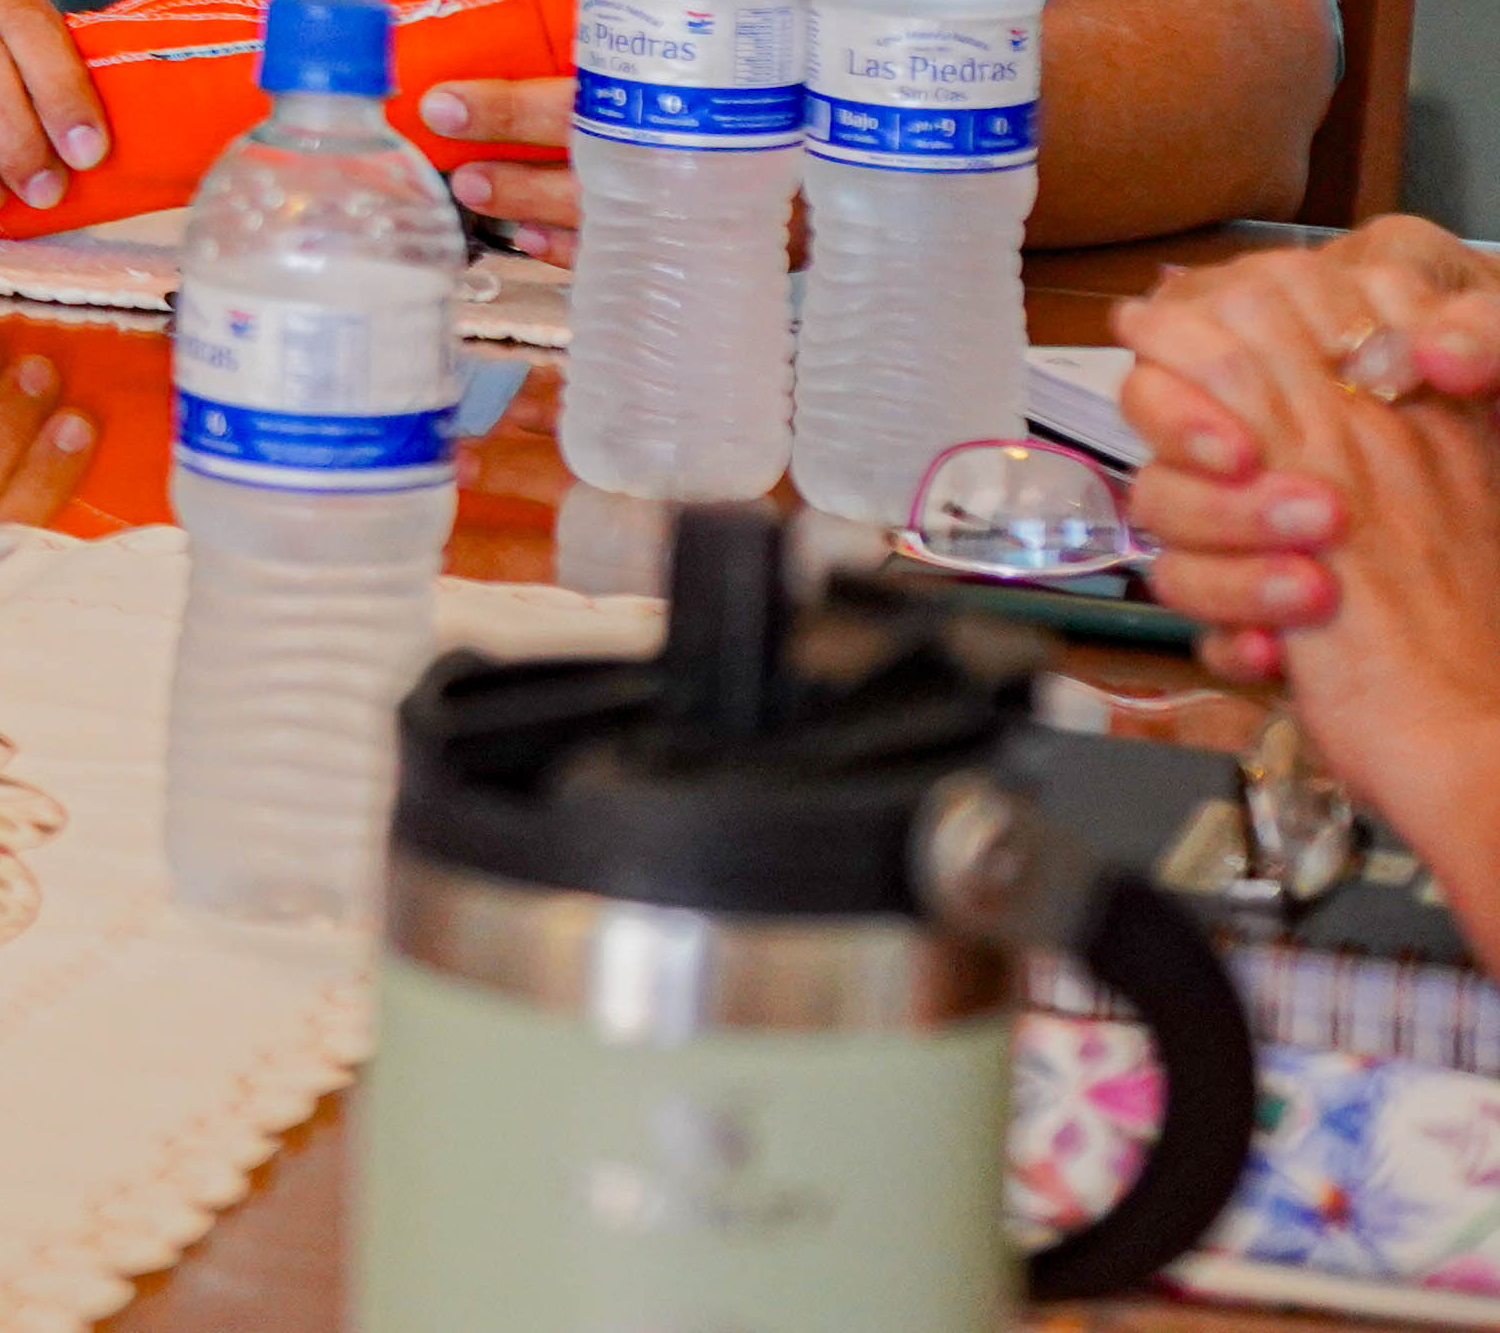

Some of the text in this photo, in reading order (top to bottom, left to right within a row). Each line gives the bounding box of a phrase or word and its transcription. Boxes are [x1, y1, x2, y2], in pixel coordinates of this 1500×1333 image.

[595, 23, 697, 62] Piedras
[847, 48, 1018, 83] Las Piedras
[835, 107, 880, 132] Bajo
